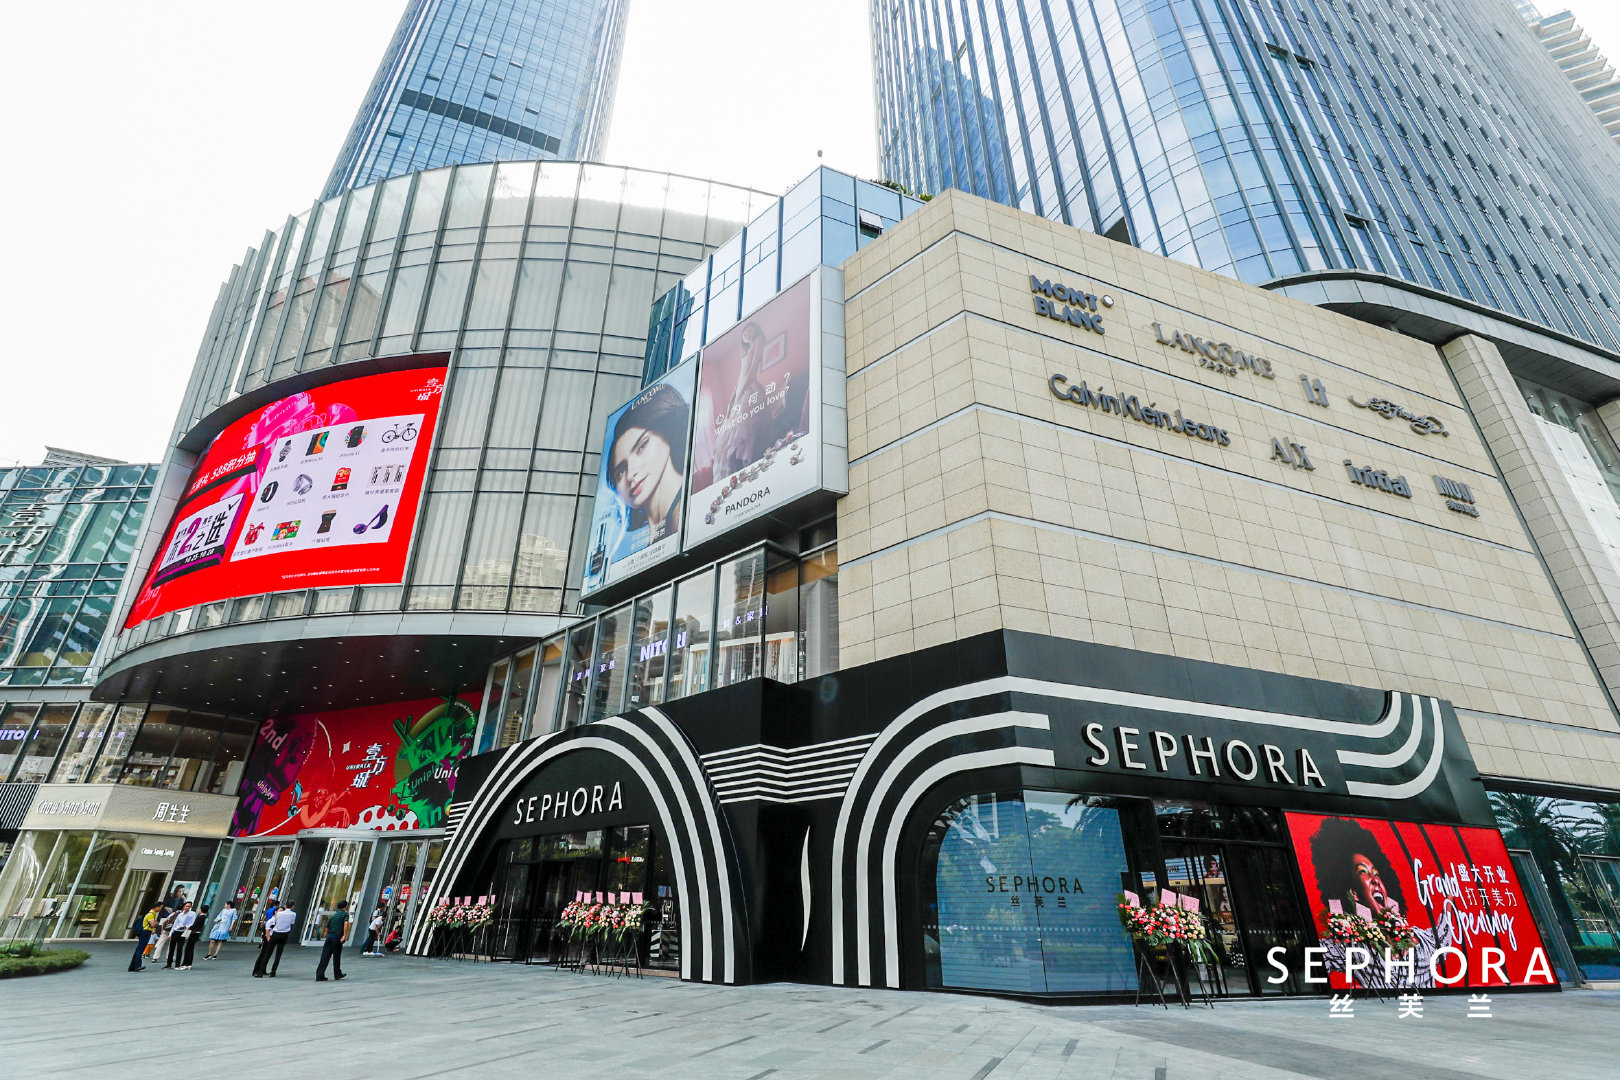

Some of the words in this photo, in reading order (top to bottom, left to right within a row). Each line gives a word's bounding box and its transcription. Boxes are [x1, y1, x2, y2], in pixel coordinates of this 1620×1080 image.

[1029, 275, 1098, 312] MONT
[1034, 296, 1105, 335] BLANC
[737, 412, 749, 423] do
[749, 402, 765, 418] you
[766, 385, 790, 406] love?
[1343, 459, 1413, 499] initial
[1432, 474, 1477, 504] MUJI
[725, 486, 771, 515] PANDORA
[259, 719, 288, 751] 2nd
[1083, 722, 1327, 788] SEPHORA
[37, 800, 60, 815] Chow
[60, 800, 80, 817] Sang
[80, 800, 101, 817] Sang
[152, 802, 190, 823] 周生生
[513, 781, 624, 825] SEPHORA
[985, 876, 1084, 894] SEPHORA
[1414, 858, 1468, 910] Grand
[1457, 863, 1510, 884] 盛大开业
[1465, 887, 1518, 908] 打开美力
[1443, 899, 1518, 951] Opening
